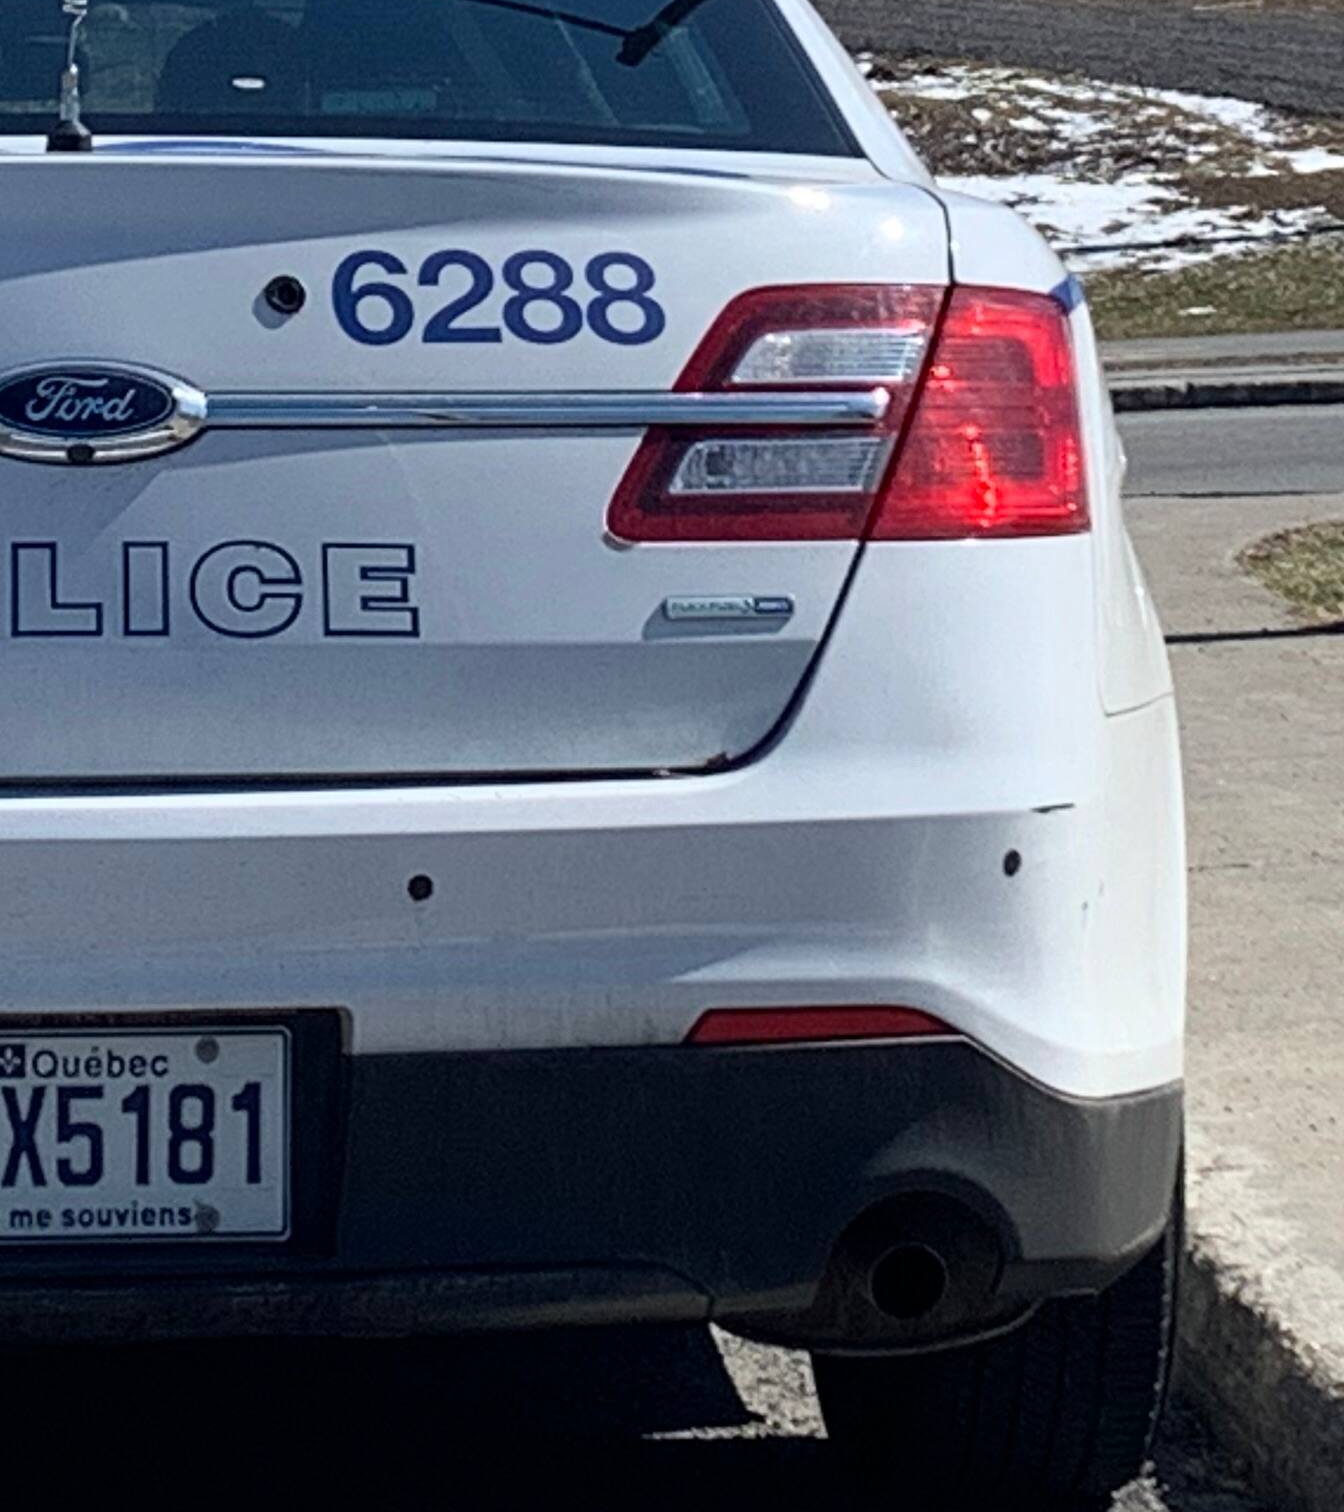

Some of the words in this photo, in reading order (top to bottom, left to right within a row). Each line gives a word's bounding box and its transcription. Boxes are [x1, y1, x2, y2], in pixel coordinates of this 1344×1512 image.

[330, 248, 666, 347] 6288
[24, 375, 137, 422] Ford
[32, 1045, 171, 1080] Québec
[9, 1208, 53, 1229] me
[61, 1202, 193, 1230] souviens
